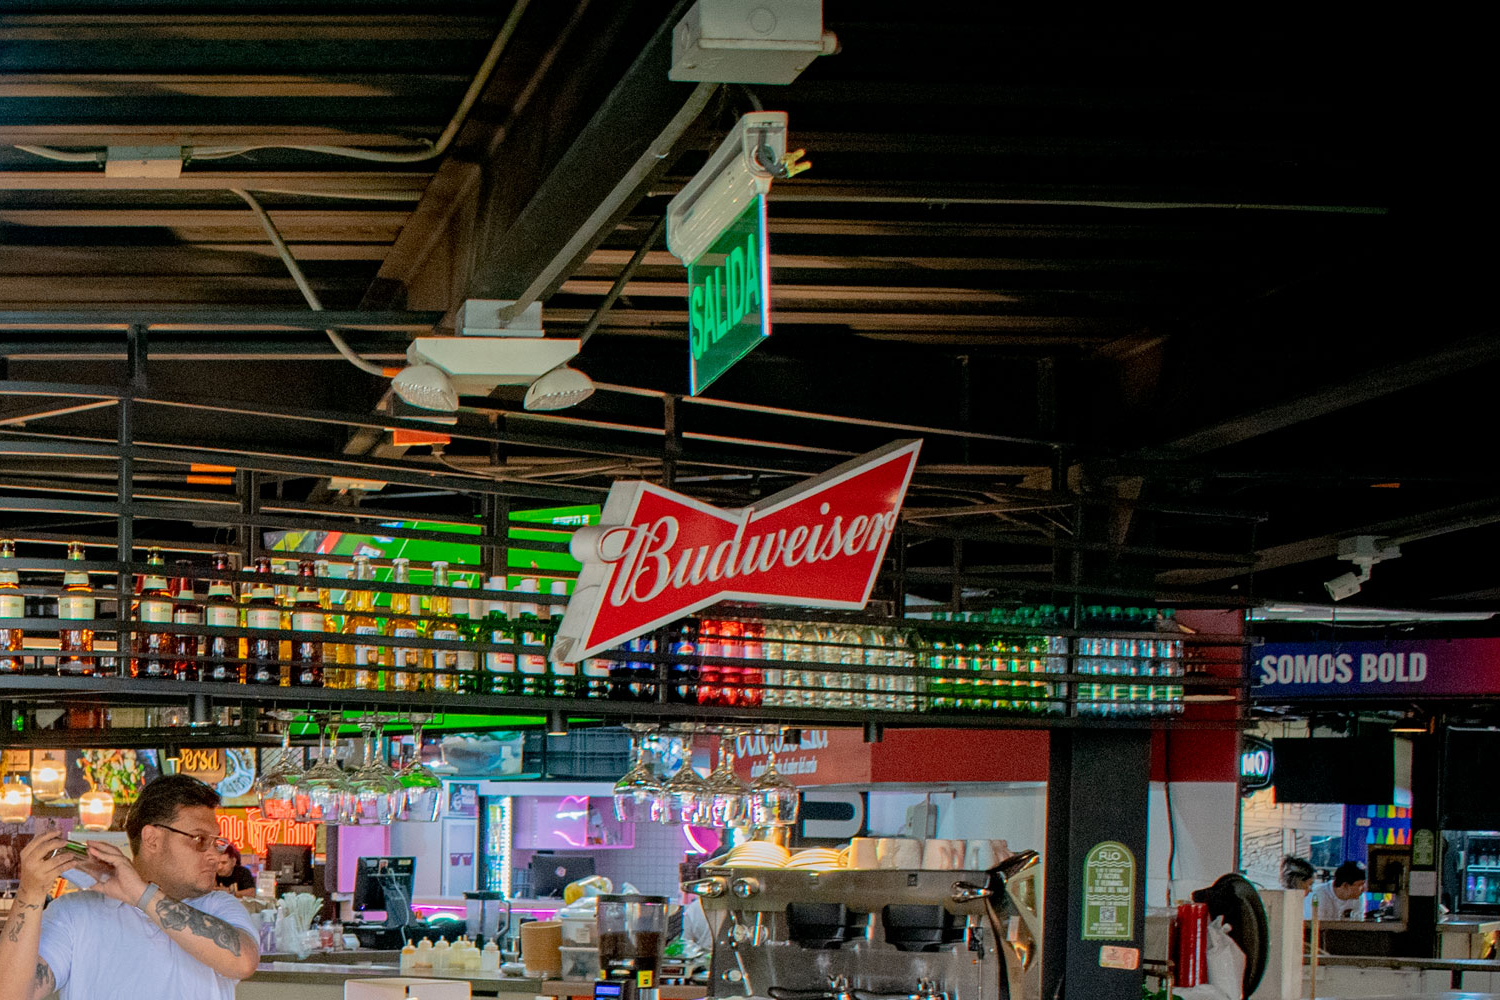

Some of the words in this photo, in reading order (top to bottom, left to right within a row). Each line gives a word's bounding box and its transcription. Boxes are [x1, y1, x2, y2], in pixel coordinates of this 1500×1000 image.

[692, 233, 760, 360] SALIDA
[599, 502, 896, 606] Budweiser
[1261, 654, 1353, 684] SOMOS
[1360, 653, 1427, 683] BOLD
